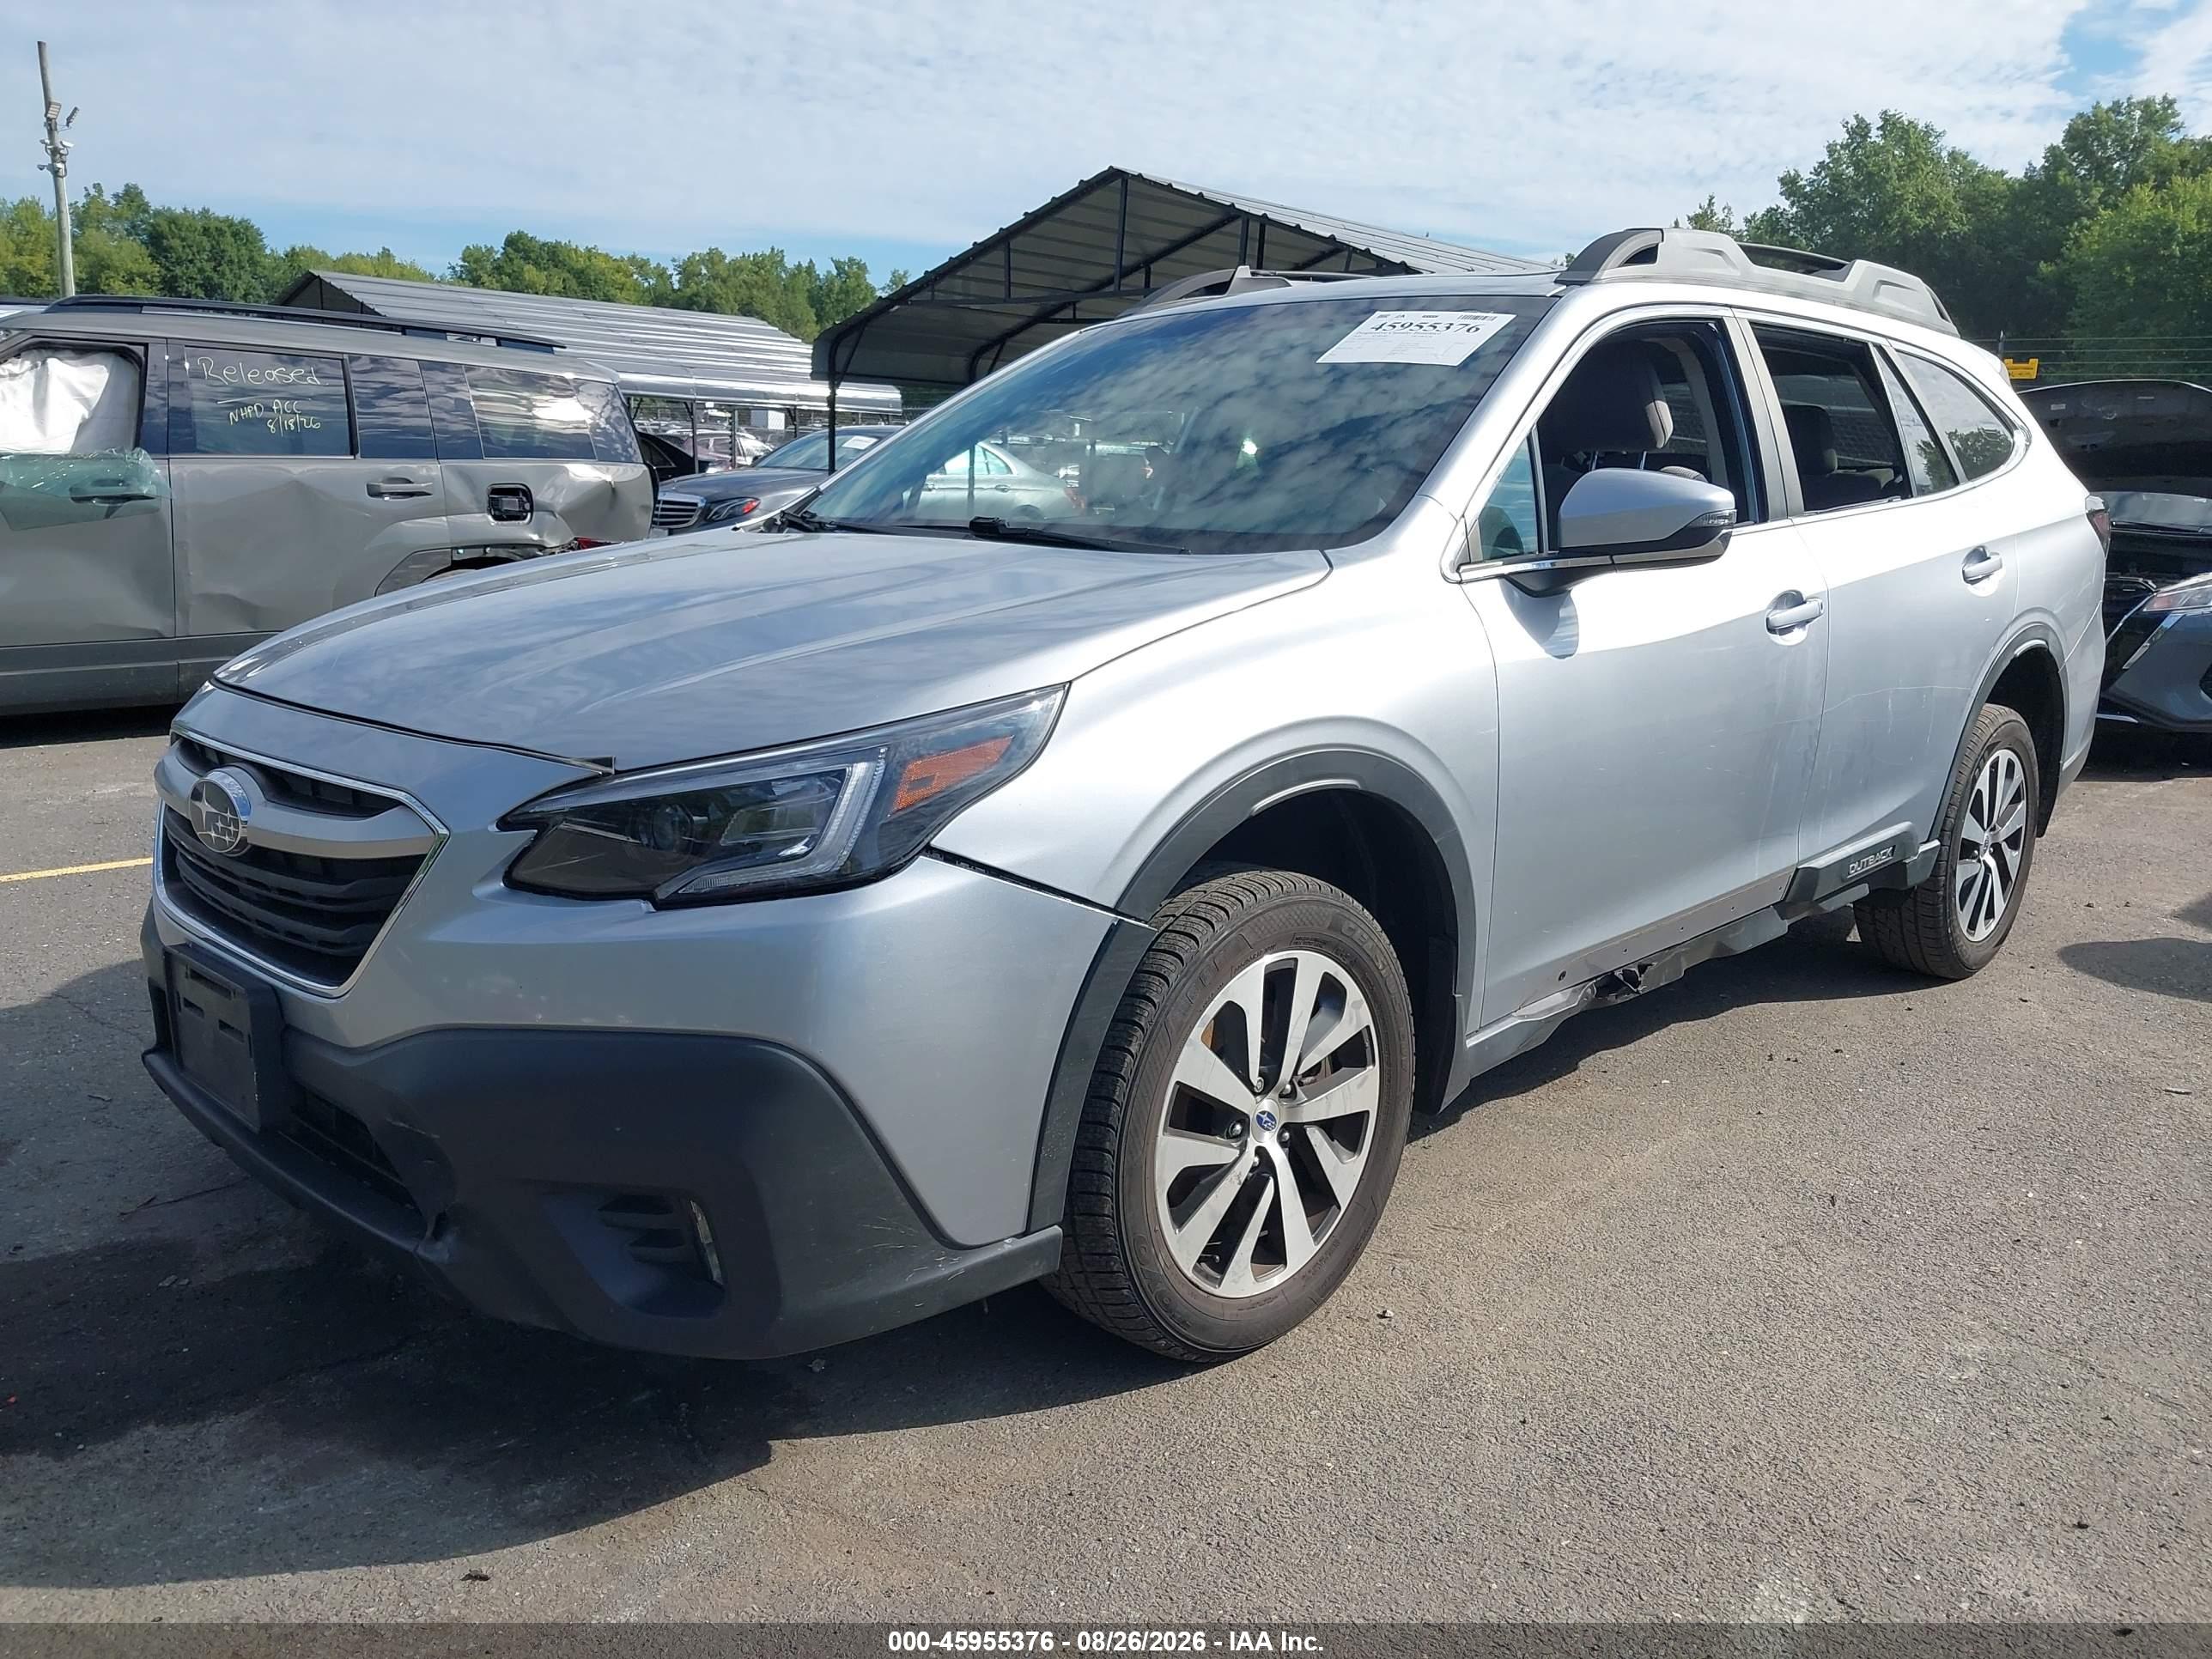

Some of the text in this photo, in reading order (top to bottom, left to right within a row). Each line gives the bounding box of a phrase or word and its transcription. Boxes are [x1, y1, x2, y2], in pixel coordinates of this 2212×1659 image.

[1370, 321, 1484, 334] 45955376
[229, 398, 303, 425] NHPD ACC
[266, 414, 321, 437] 8/18/26
[1849, 847, 1893, 874] OUTBACK
